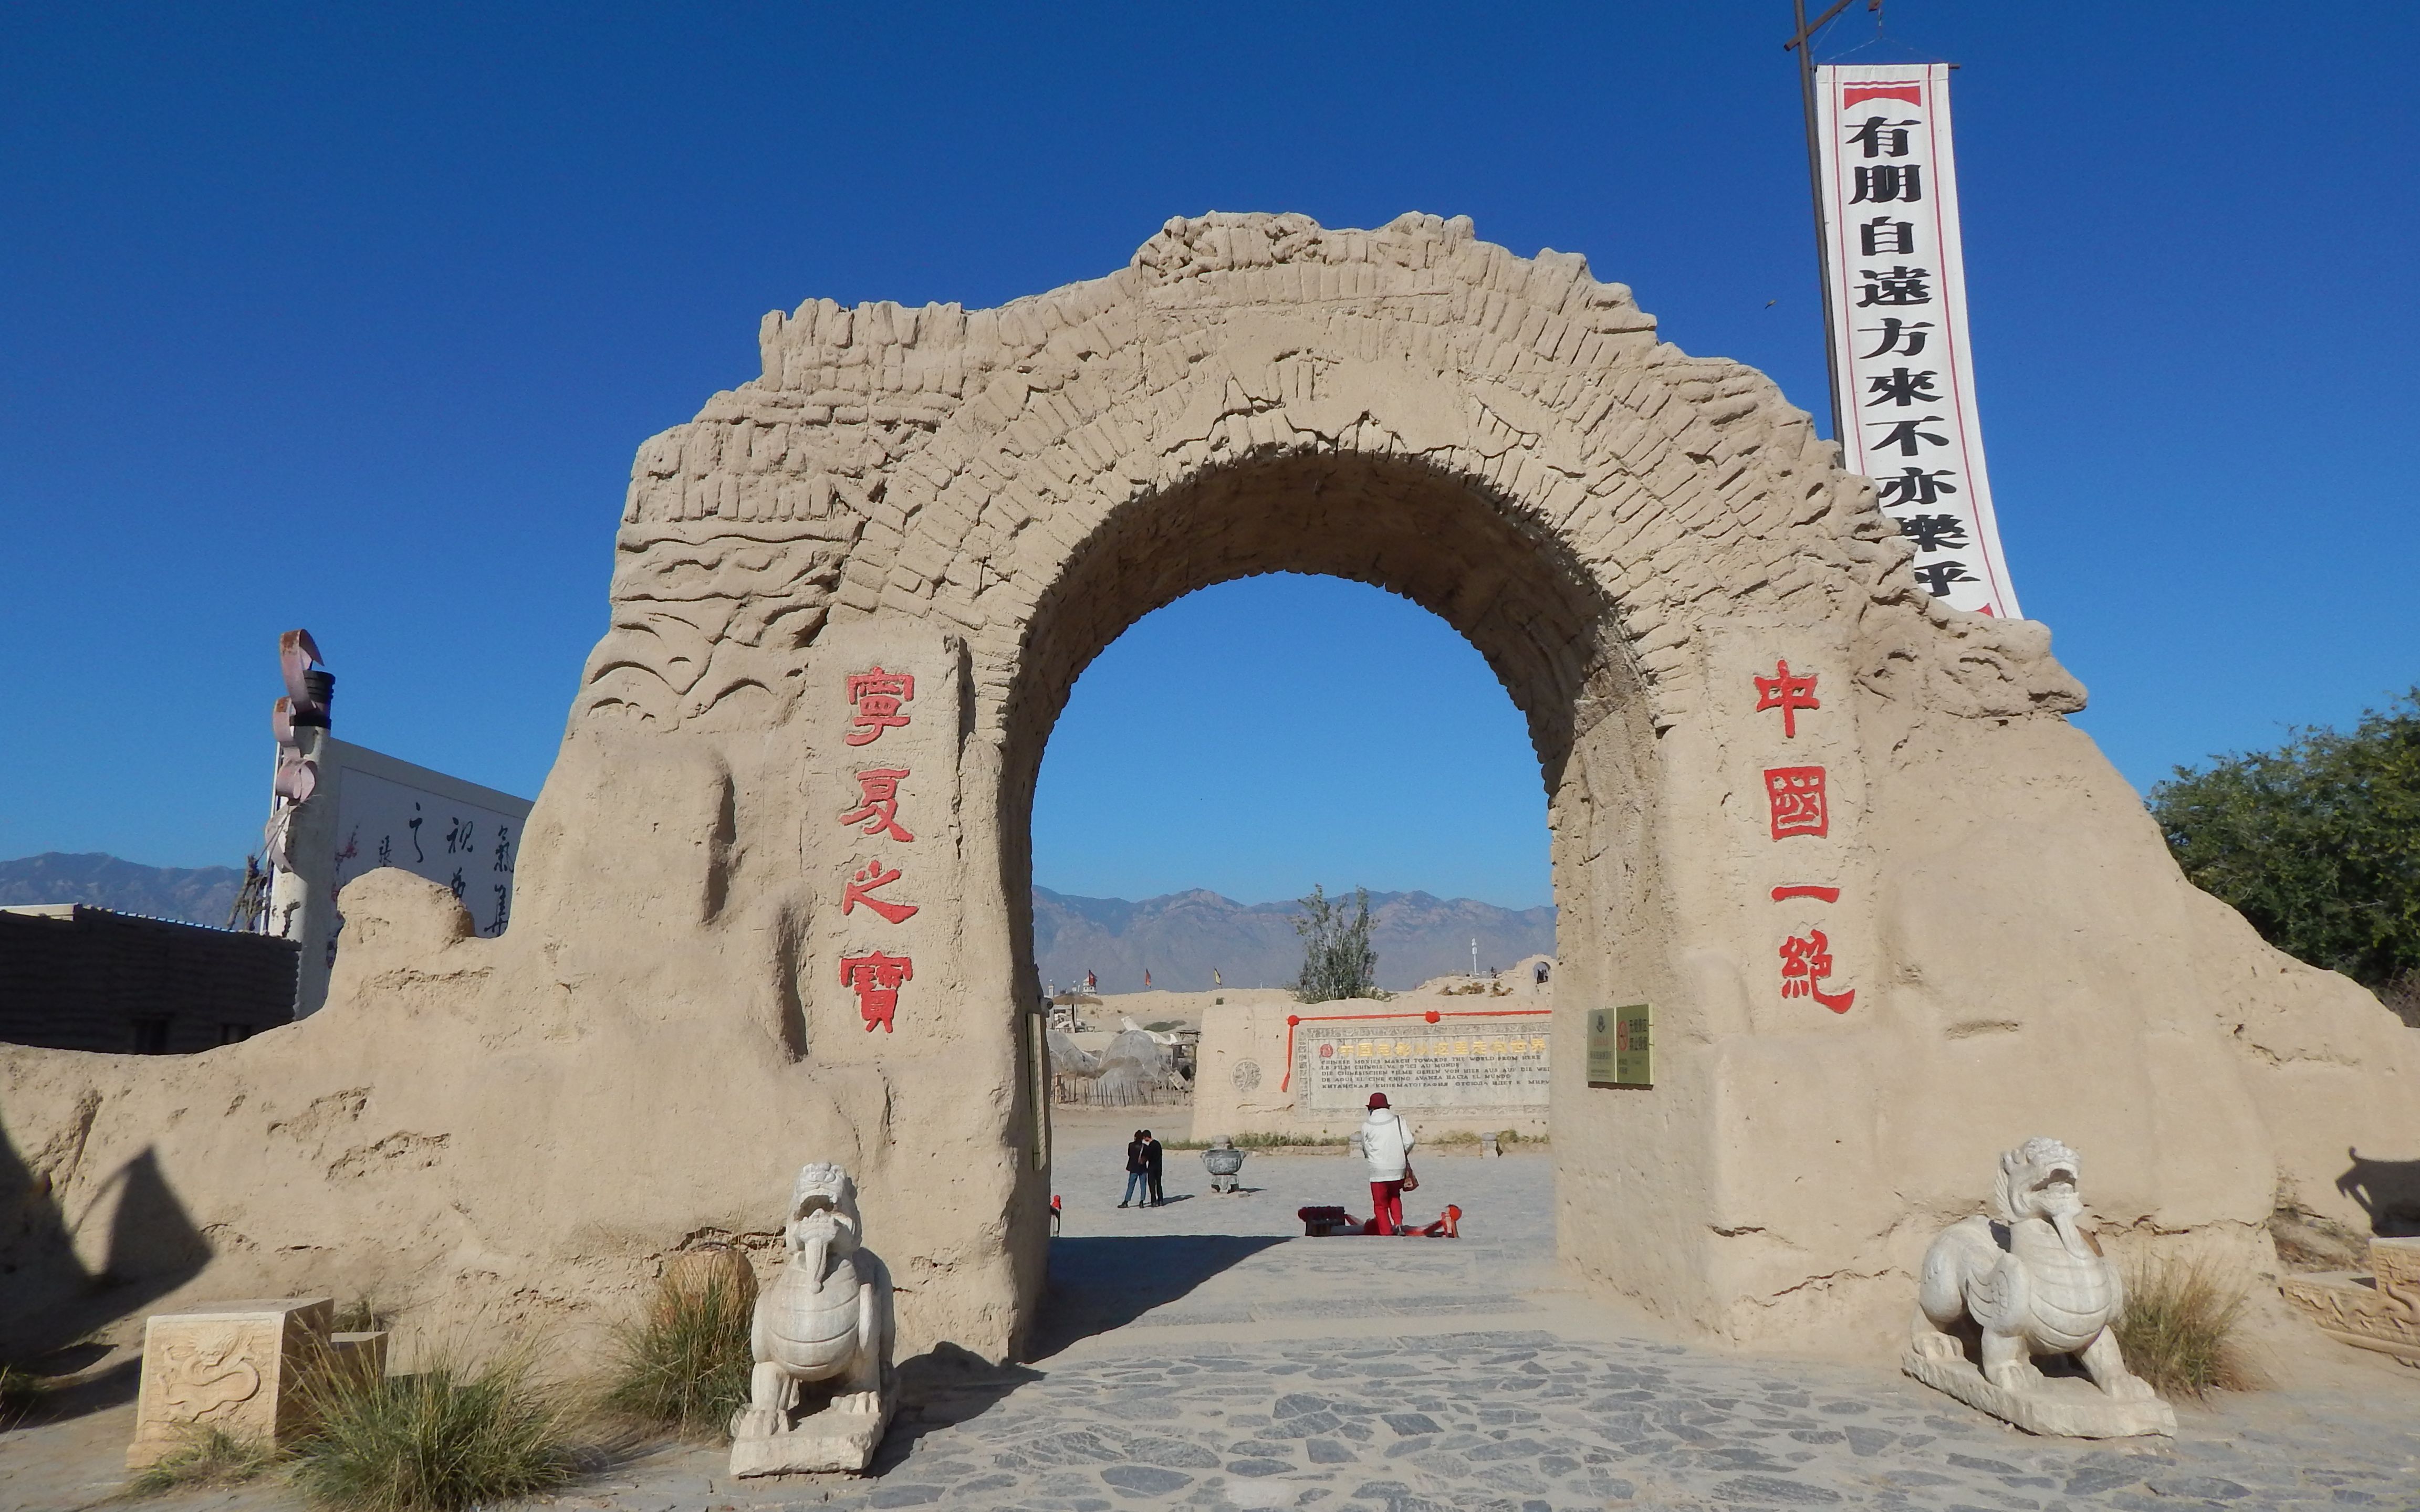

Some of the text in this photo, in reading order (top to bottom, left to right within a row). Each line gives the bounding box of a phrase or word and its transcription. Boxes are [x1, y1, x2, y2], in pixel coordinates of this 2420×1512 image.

[1844, 117, 1980, 597] 有朋自遠方來不亦樂乎
[840, 666, 918, 1033] 寧夏之寶
[1338, 1038, 1546, 1057] 中国电影从这里走向世界
